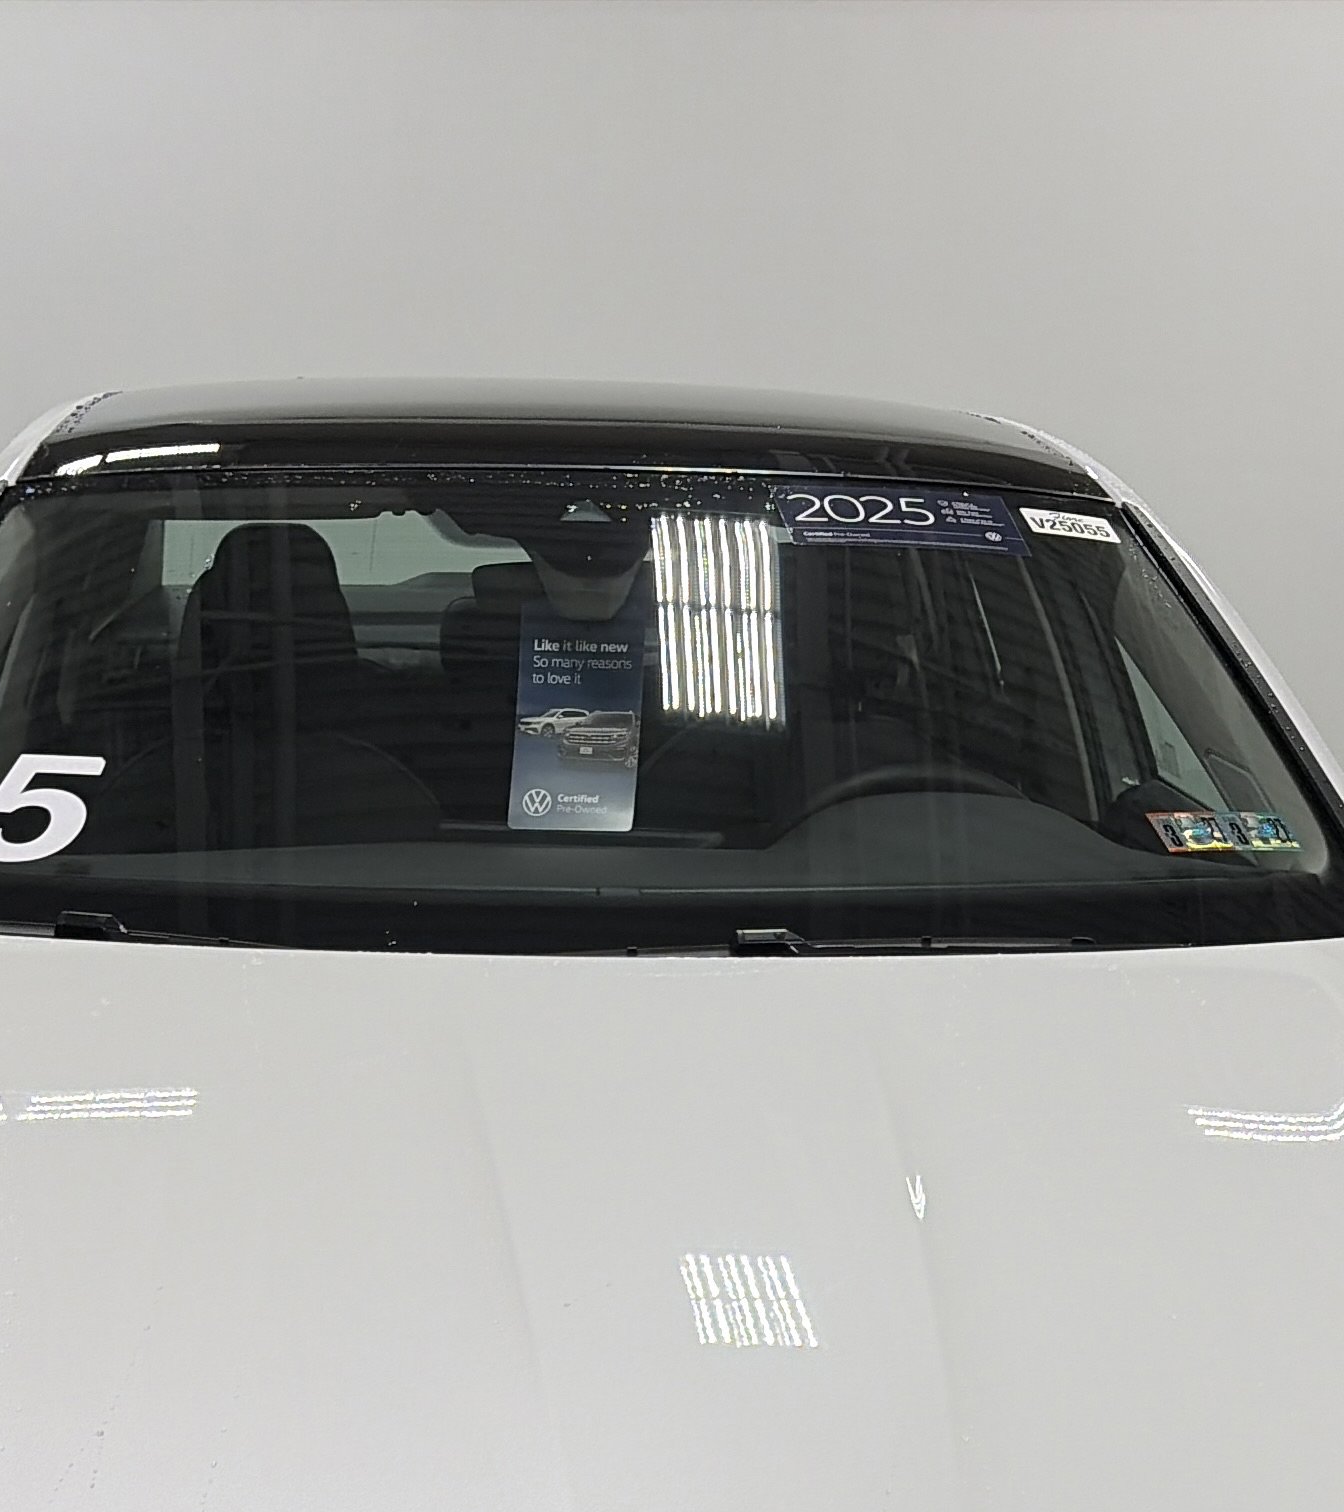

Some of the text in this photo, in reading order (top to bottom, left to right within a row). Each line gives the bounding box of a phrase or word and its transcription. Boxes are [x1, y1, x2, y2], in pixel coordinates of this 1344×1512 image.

[786, 493, 936, 526] 2025
[1029, 516, 1111, 538] V25055
[533, 639, 629, 653] Like it like new
[532, 656, 633, 671] So many reasons
[532, 672, 582, 685] to love it
[522, 788, 552, 817] VW
[557, 793, 600, 804] Certified
[556, 805, 607, 815] Pre-Owned
[1162, 823, 1184, 847] 3
[1228, 822, 1250, 846] 3
